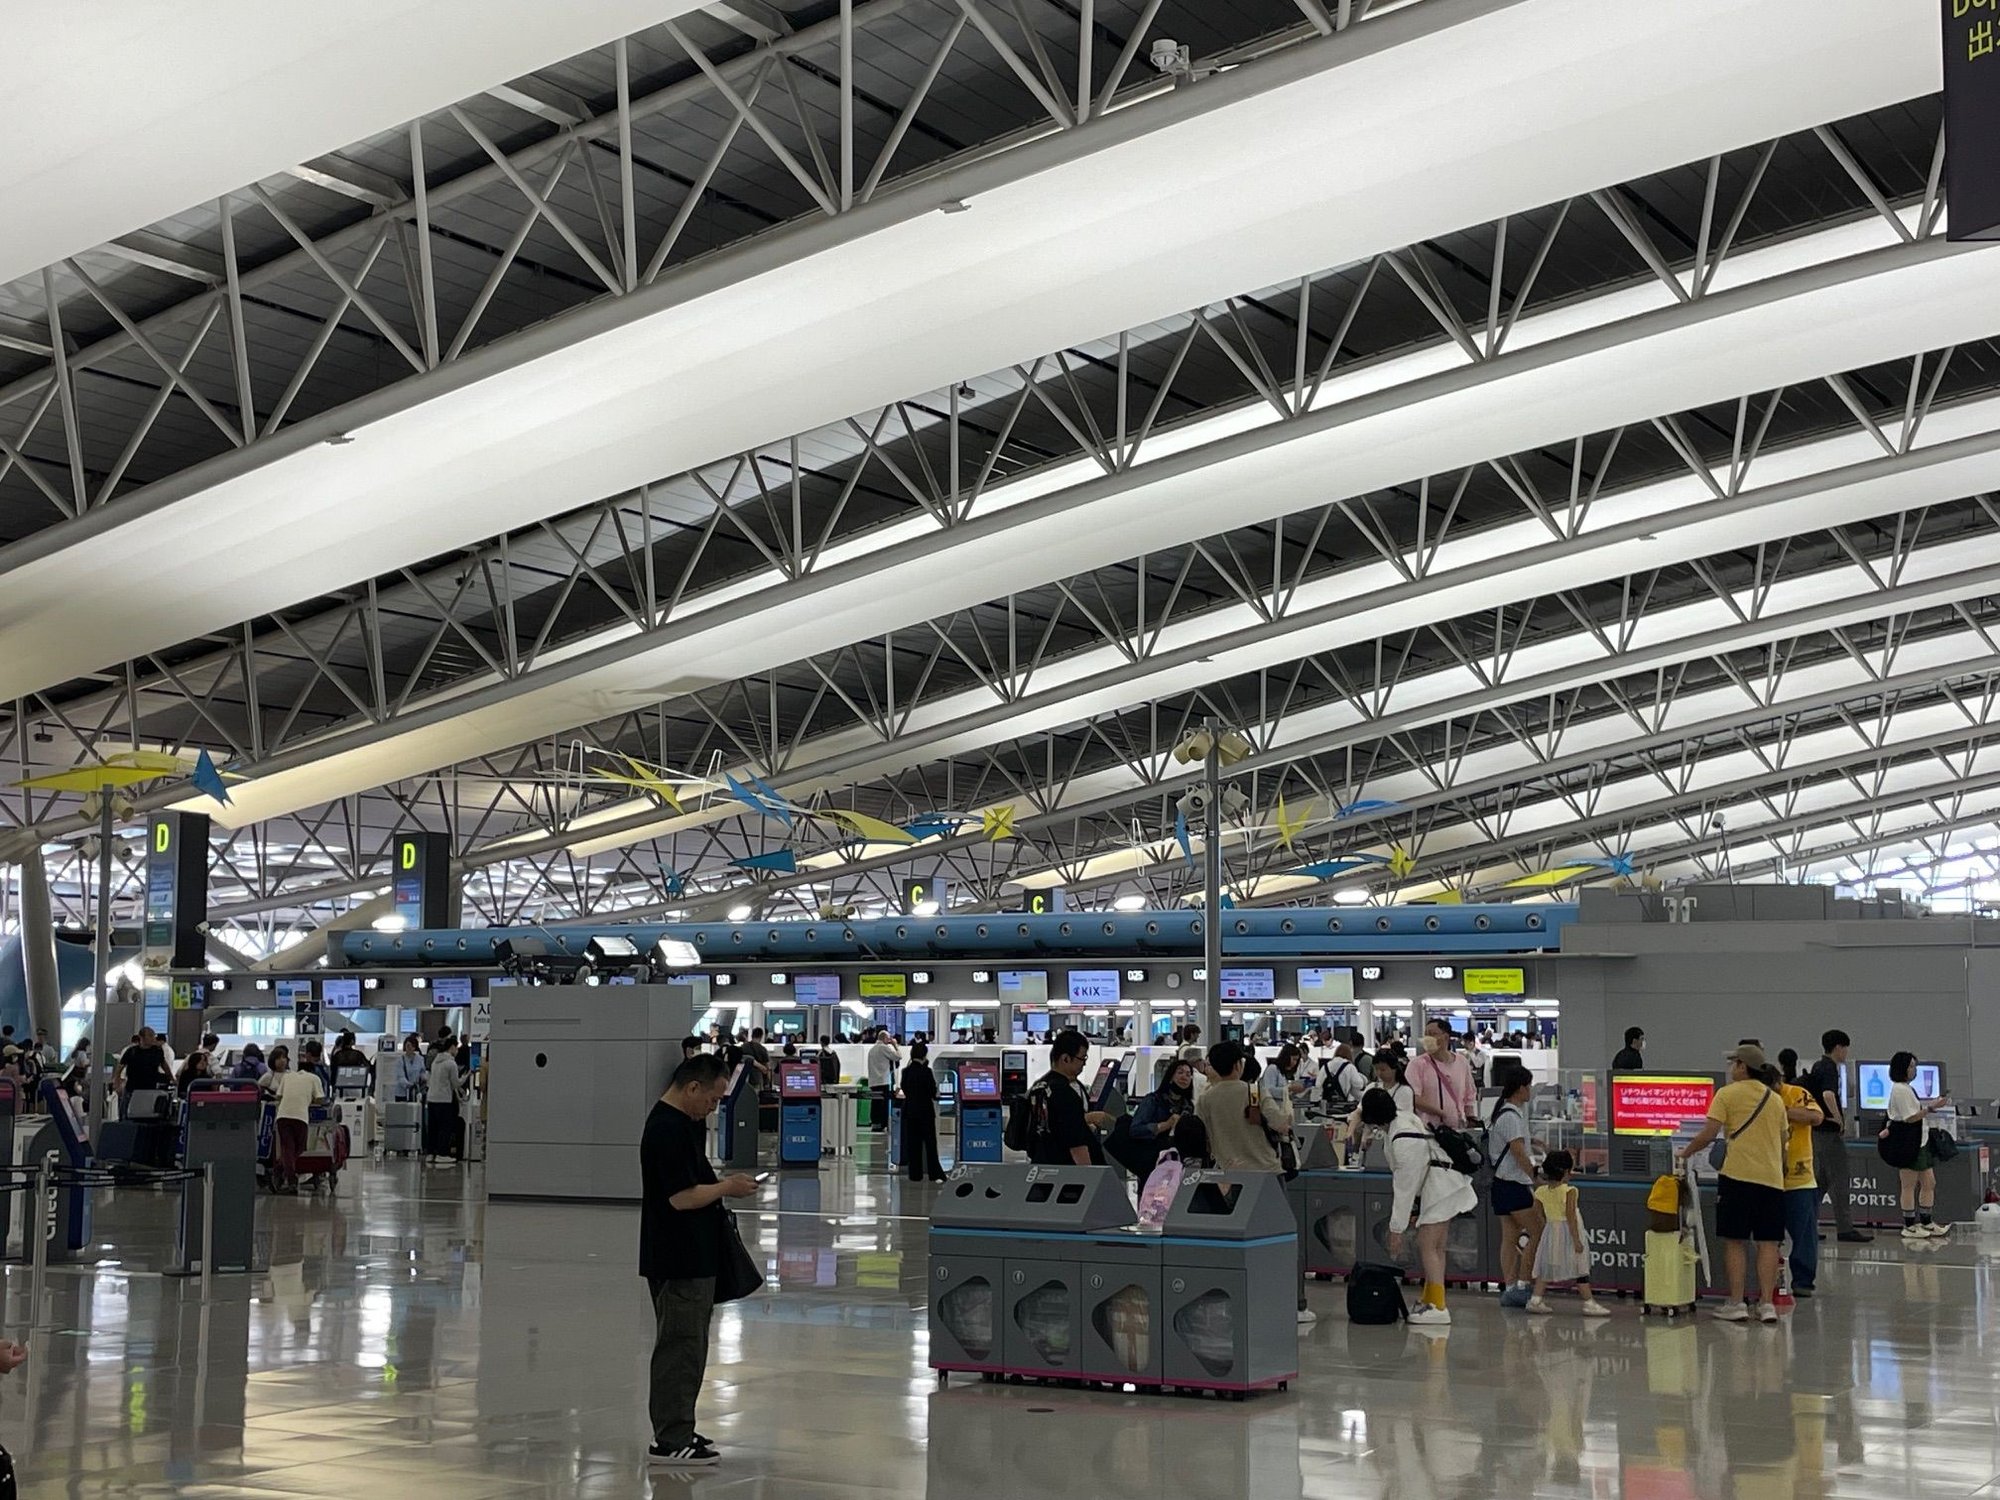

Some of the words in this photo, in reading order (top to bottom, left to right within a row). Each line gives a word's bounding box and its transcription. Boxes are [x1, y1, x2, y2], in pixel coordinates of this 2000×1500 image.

[1969, 20, 2000, 61] 出
[156, 823, 169, 852] D
[403, 843, 416, 869] D
[911, 885, 923, 906] C
[1032, 895, 1044, 914] C
[1128, 970, 1144, 981] D25
[1362, 968, 1380, 979] D27
[1082, 986, 1100, 996] KIX
[304, 1002, 312, 1013] 2
[1849, 1177, 1877, 1189] SAI
